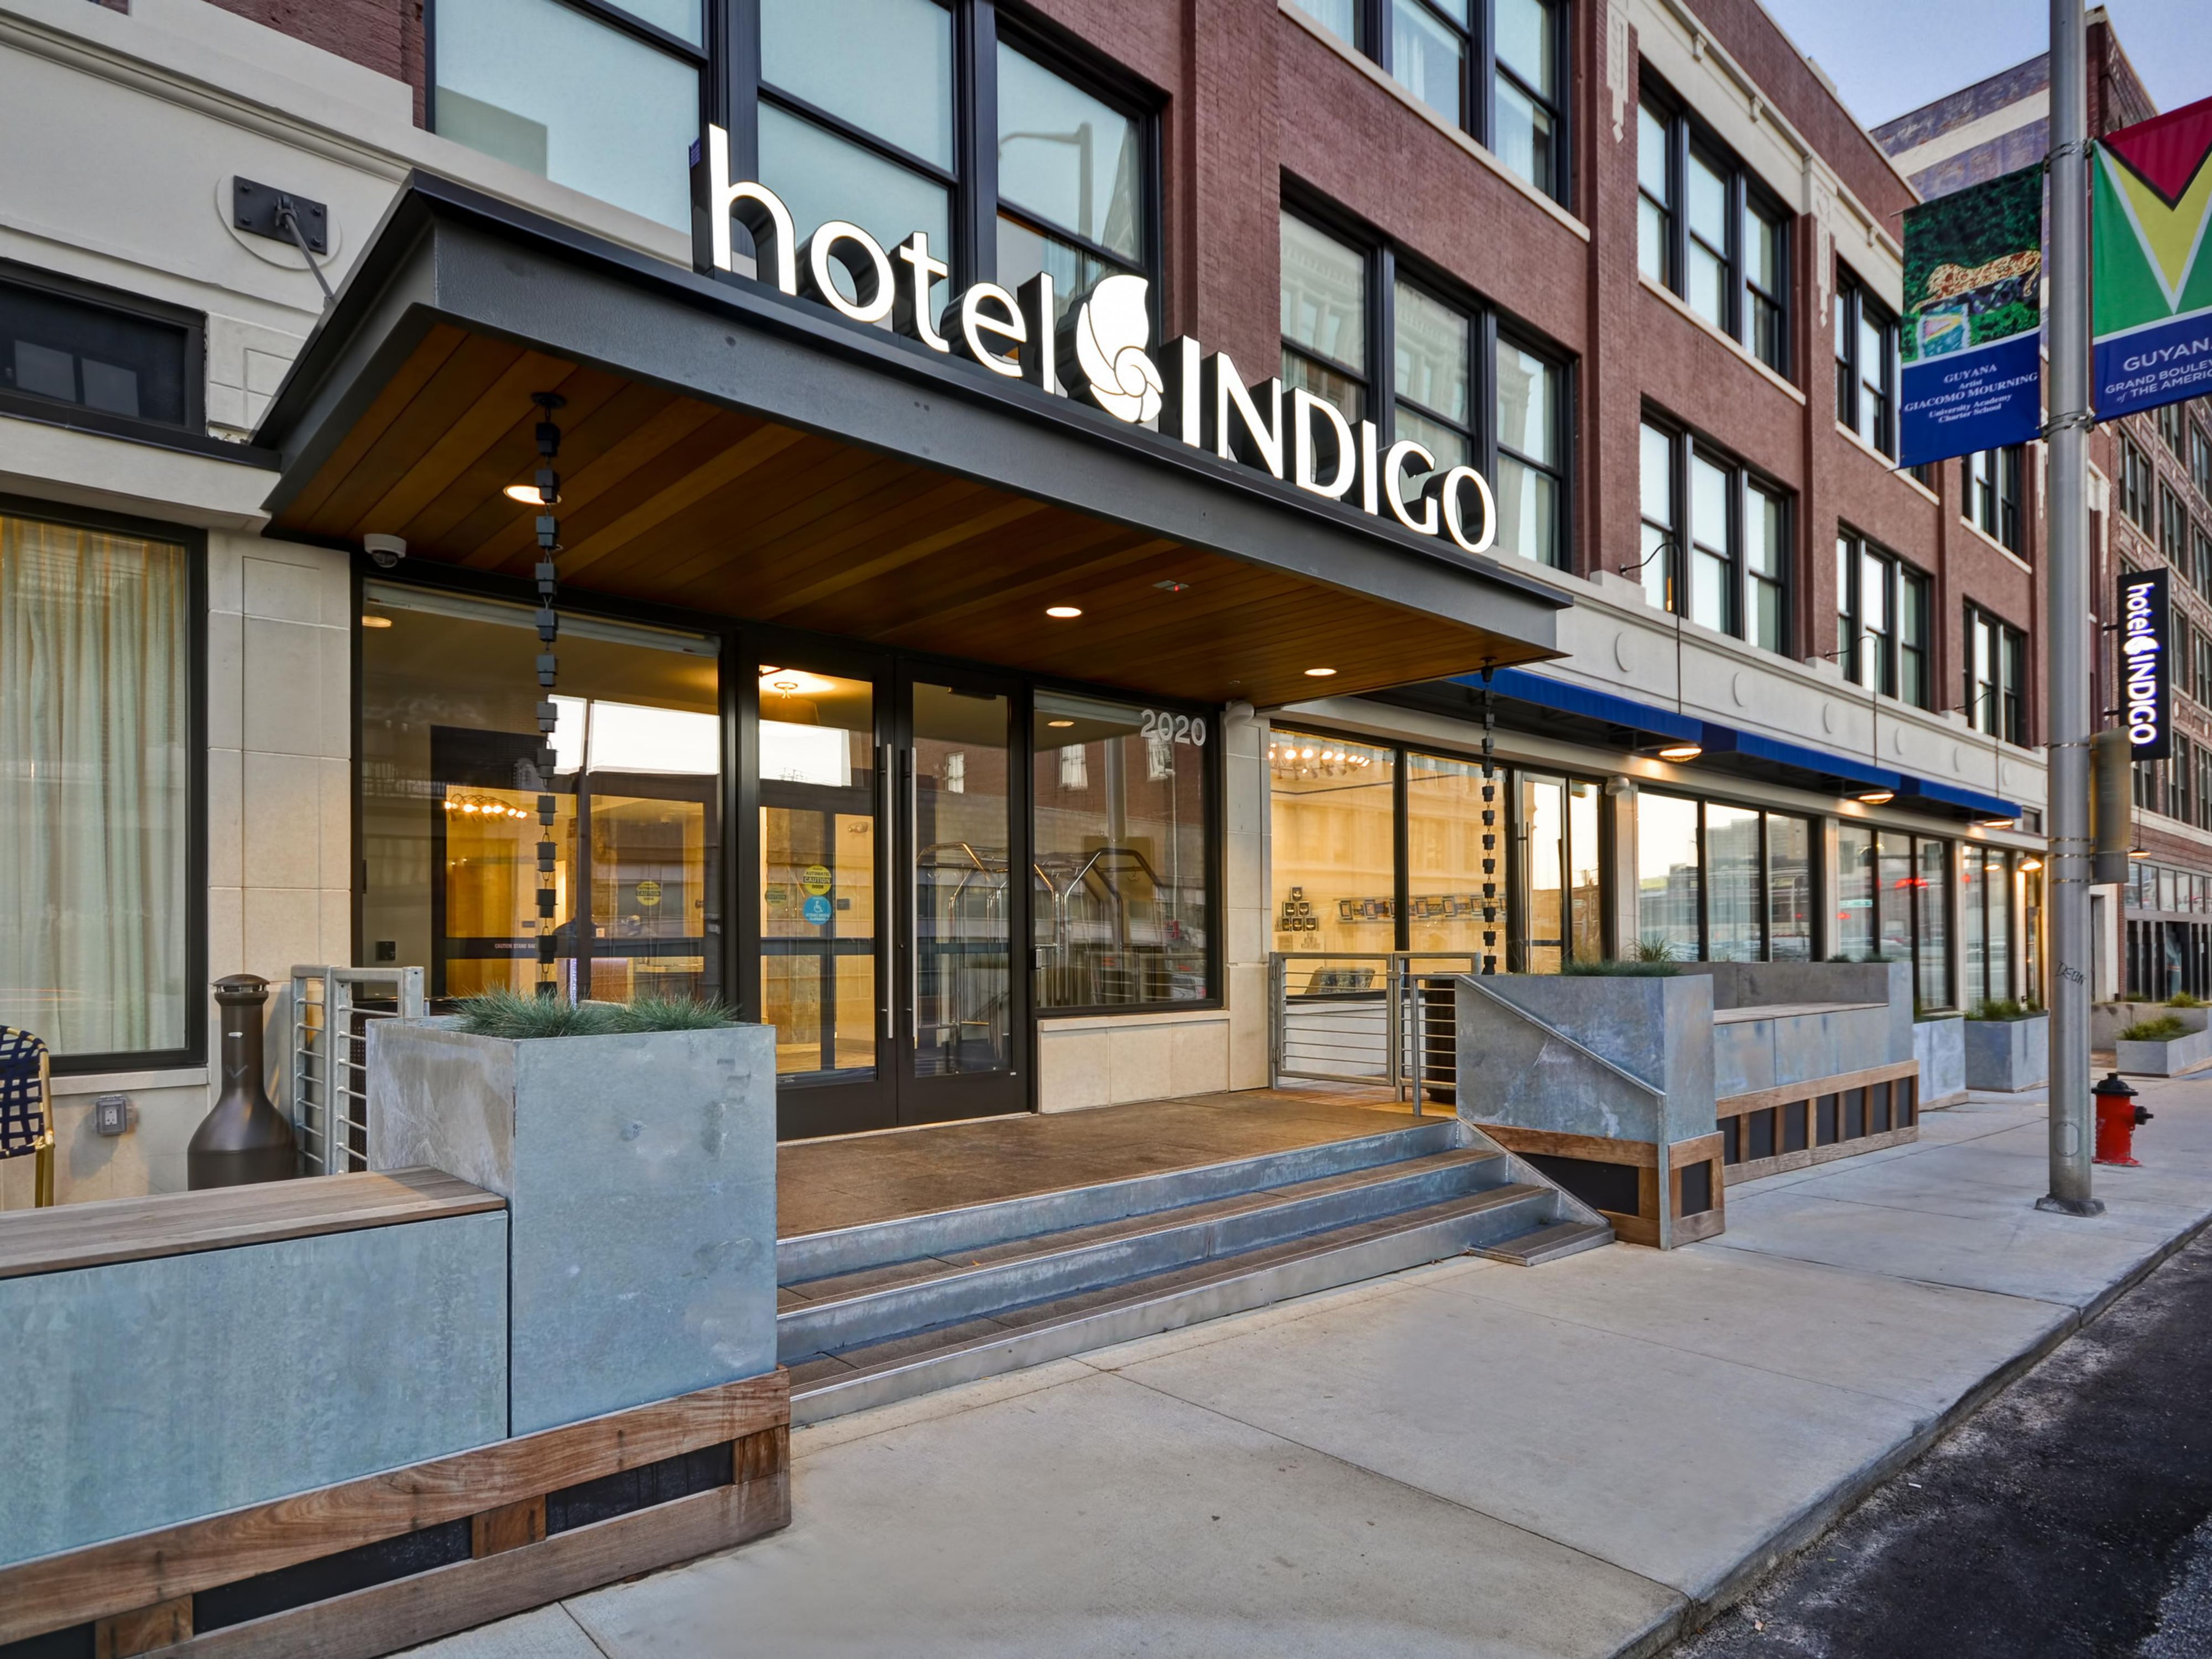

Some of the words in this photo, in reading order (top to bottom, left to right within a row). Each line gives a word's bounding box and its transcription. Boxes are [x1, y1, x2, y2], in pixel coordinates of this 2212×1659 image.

[709, 123, 1056, 395] hotel
[1182, 335, 1497, 554] INDIGO
[2124, 337, 2212, 372] GUYAN
[1943, 364, 1997, 383] GUYANA
[1958, 379, 1983, 390] Artist
[2105, 374, 2156, 394] GRAND
[1904, 390, 1965, 412] GIACOMO
[1967, 372, 2039, 398] MOURNING
[1929, 403, 1971, 418] University
[1973, 394, 2012, 408] Academy
[2116, 392, 2128, 404] of
[2130, 383, 2158, 398] THE
[1938, 411, 1971, 424] Charter
[1973, 403, 2002, 415] School
[2126, 582, 2156, 637] hotel
[2127, 653, 2157, 745] INDIGO
[1140, 709, 1207, 747] 2020
